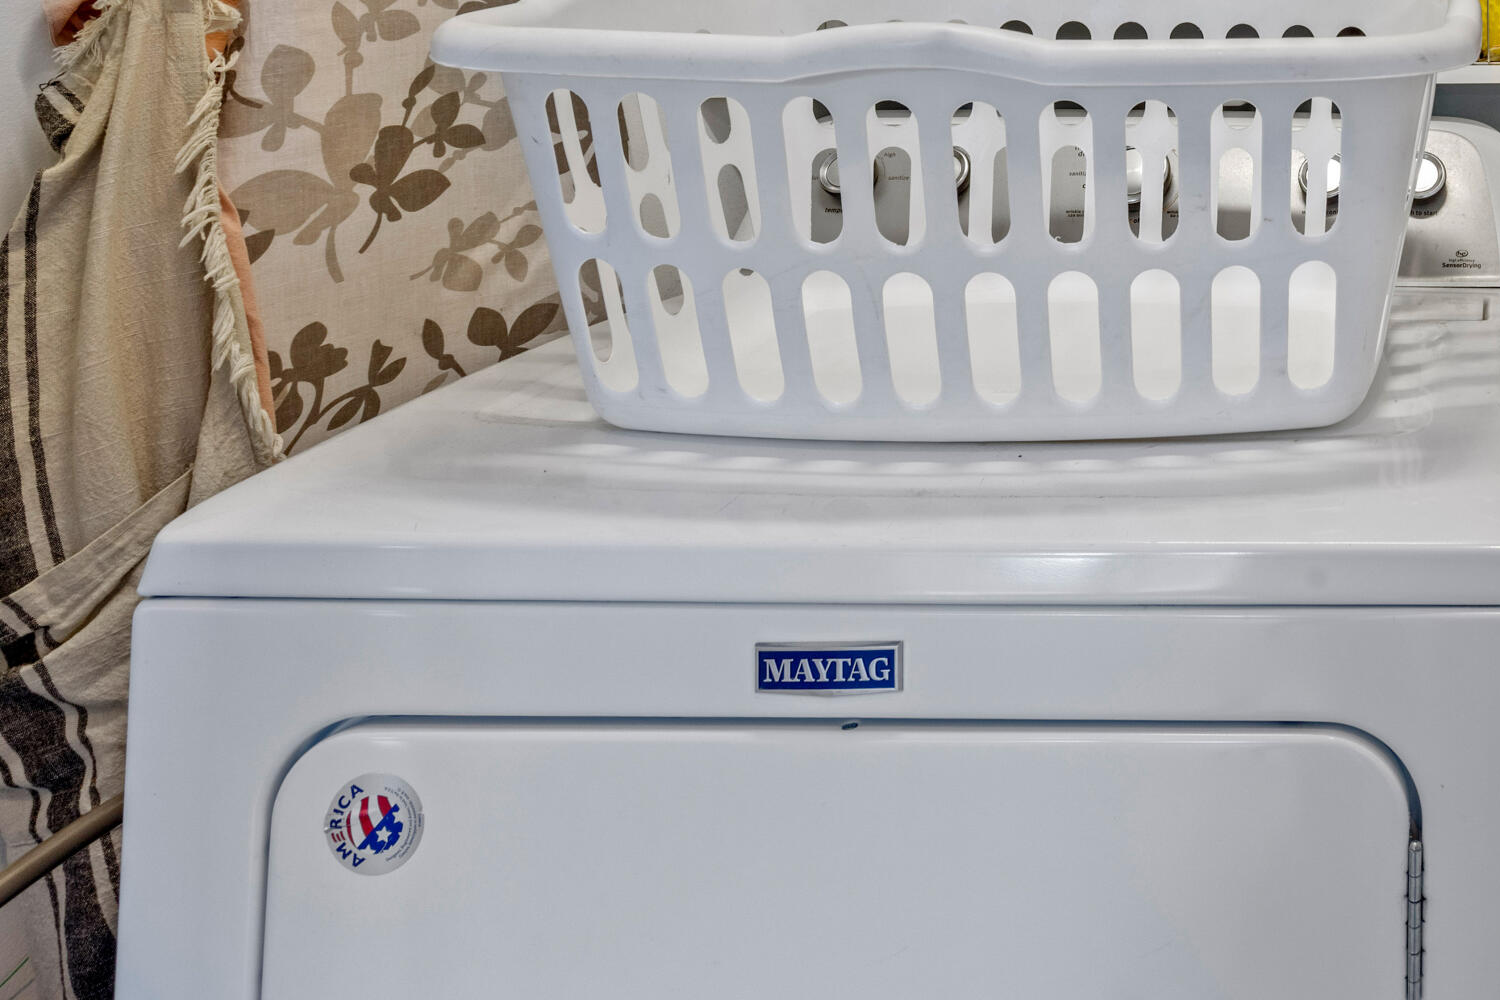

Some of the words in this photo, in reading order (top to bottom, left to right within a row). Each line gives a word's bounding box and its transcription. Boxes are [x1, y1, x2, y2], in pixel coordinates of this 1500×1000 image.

[1441, 261, 1482, 270] SensorDrying
[762, 657, 892, 683] MAYTAG
[329, 783, 367, 868] AMERICA
